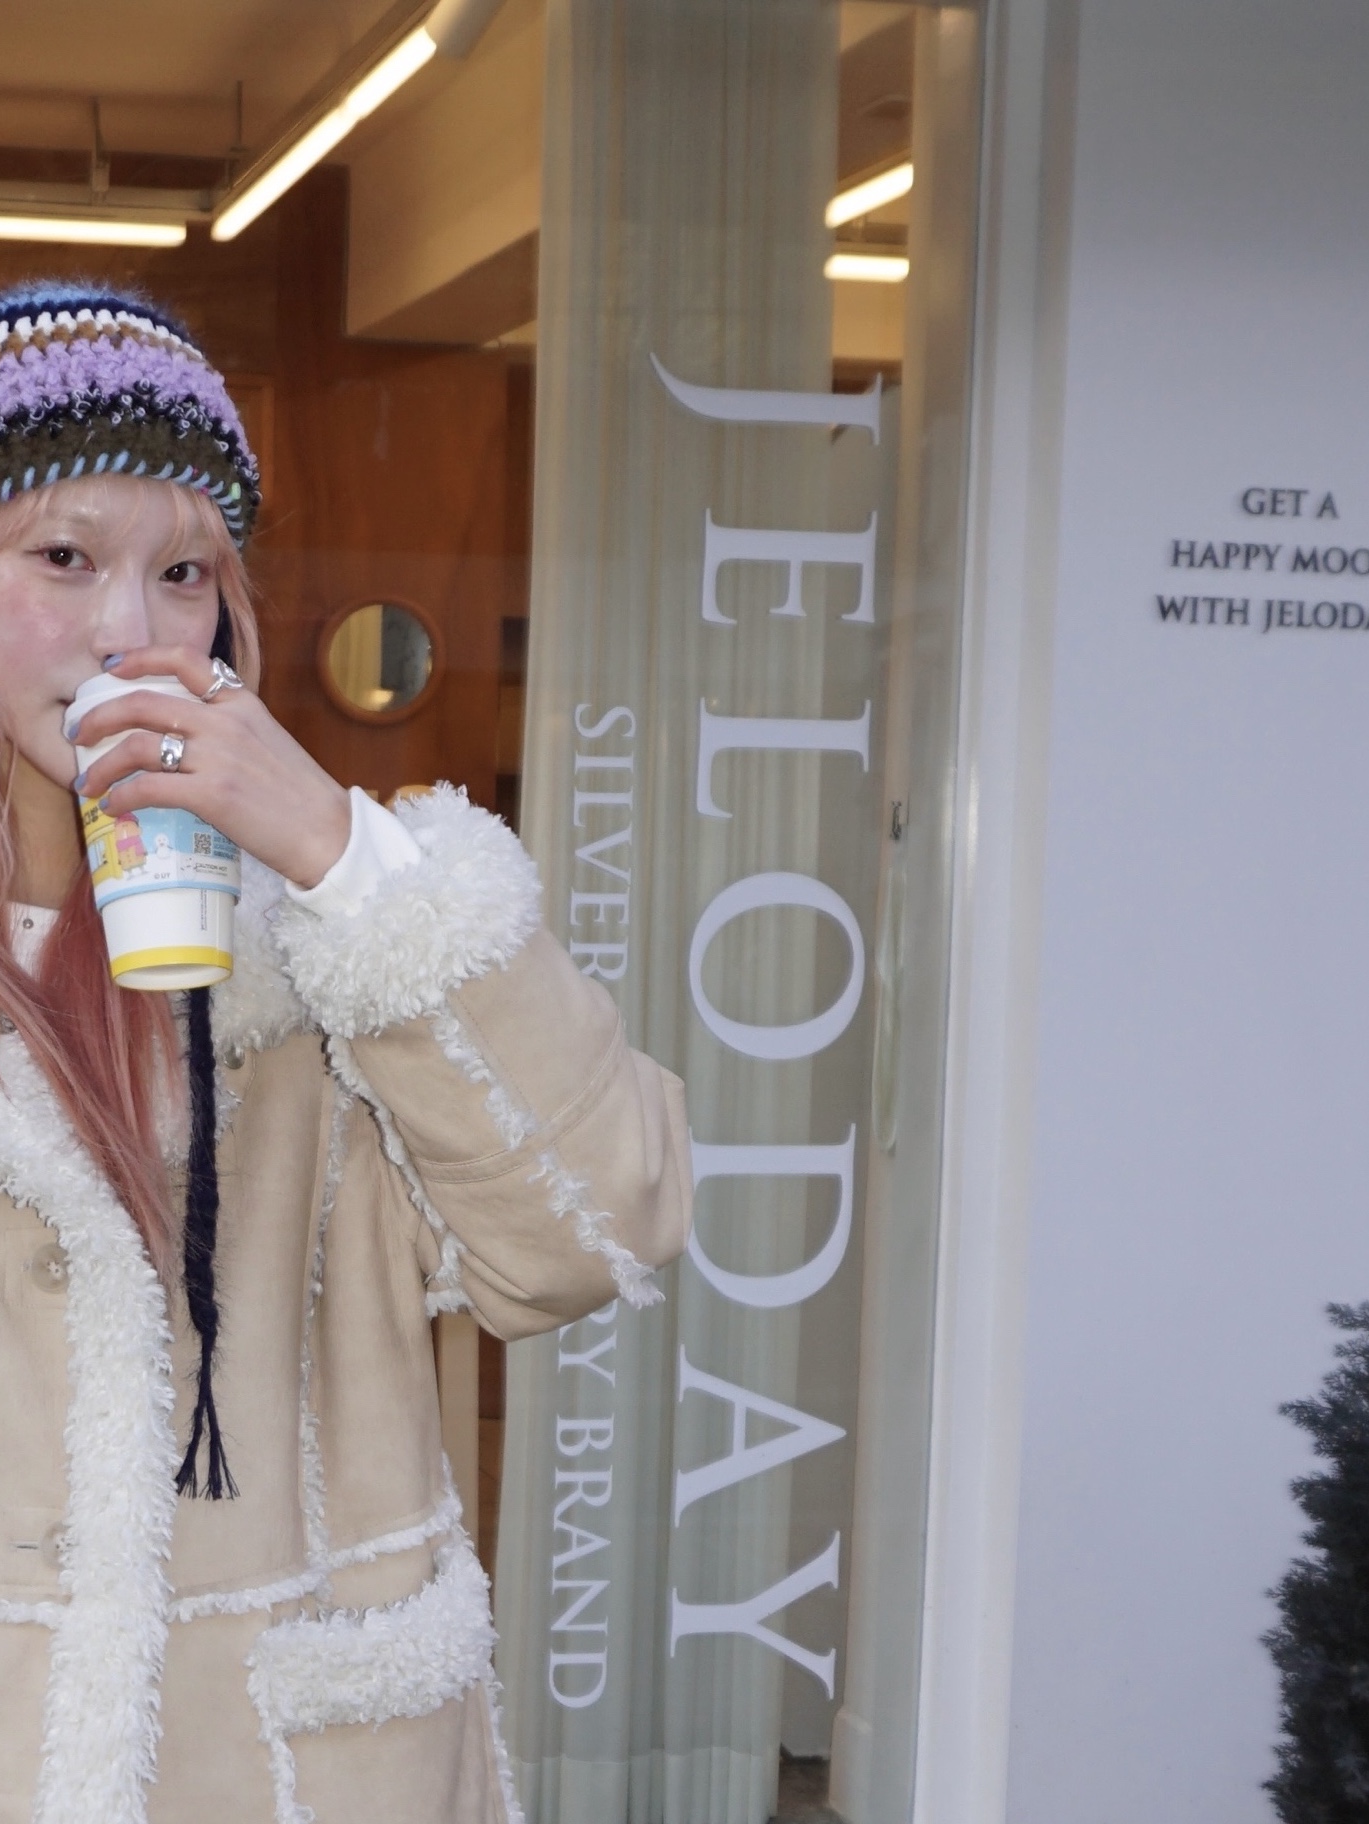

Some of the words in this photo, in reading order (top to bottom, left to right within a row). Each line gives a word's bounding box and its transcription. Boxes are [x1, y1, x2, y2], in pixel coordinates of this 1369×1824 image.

[1170, 539, 1283, 571] HAPPY
[1242, 487, 1309, 516] GET
[1316, 491, 1339, 519] A
[1155, 594, 1250, 625] WITH
[1262, 599, 1369, 634] JELOD
[570, 703, 636, 981] SILVER
[650, 352, 883, 1700] JELODAY
[549, 1415, 614, 1708] BRAND
